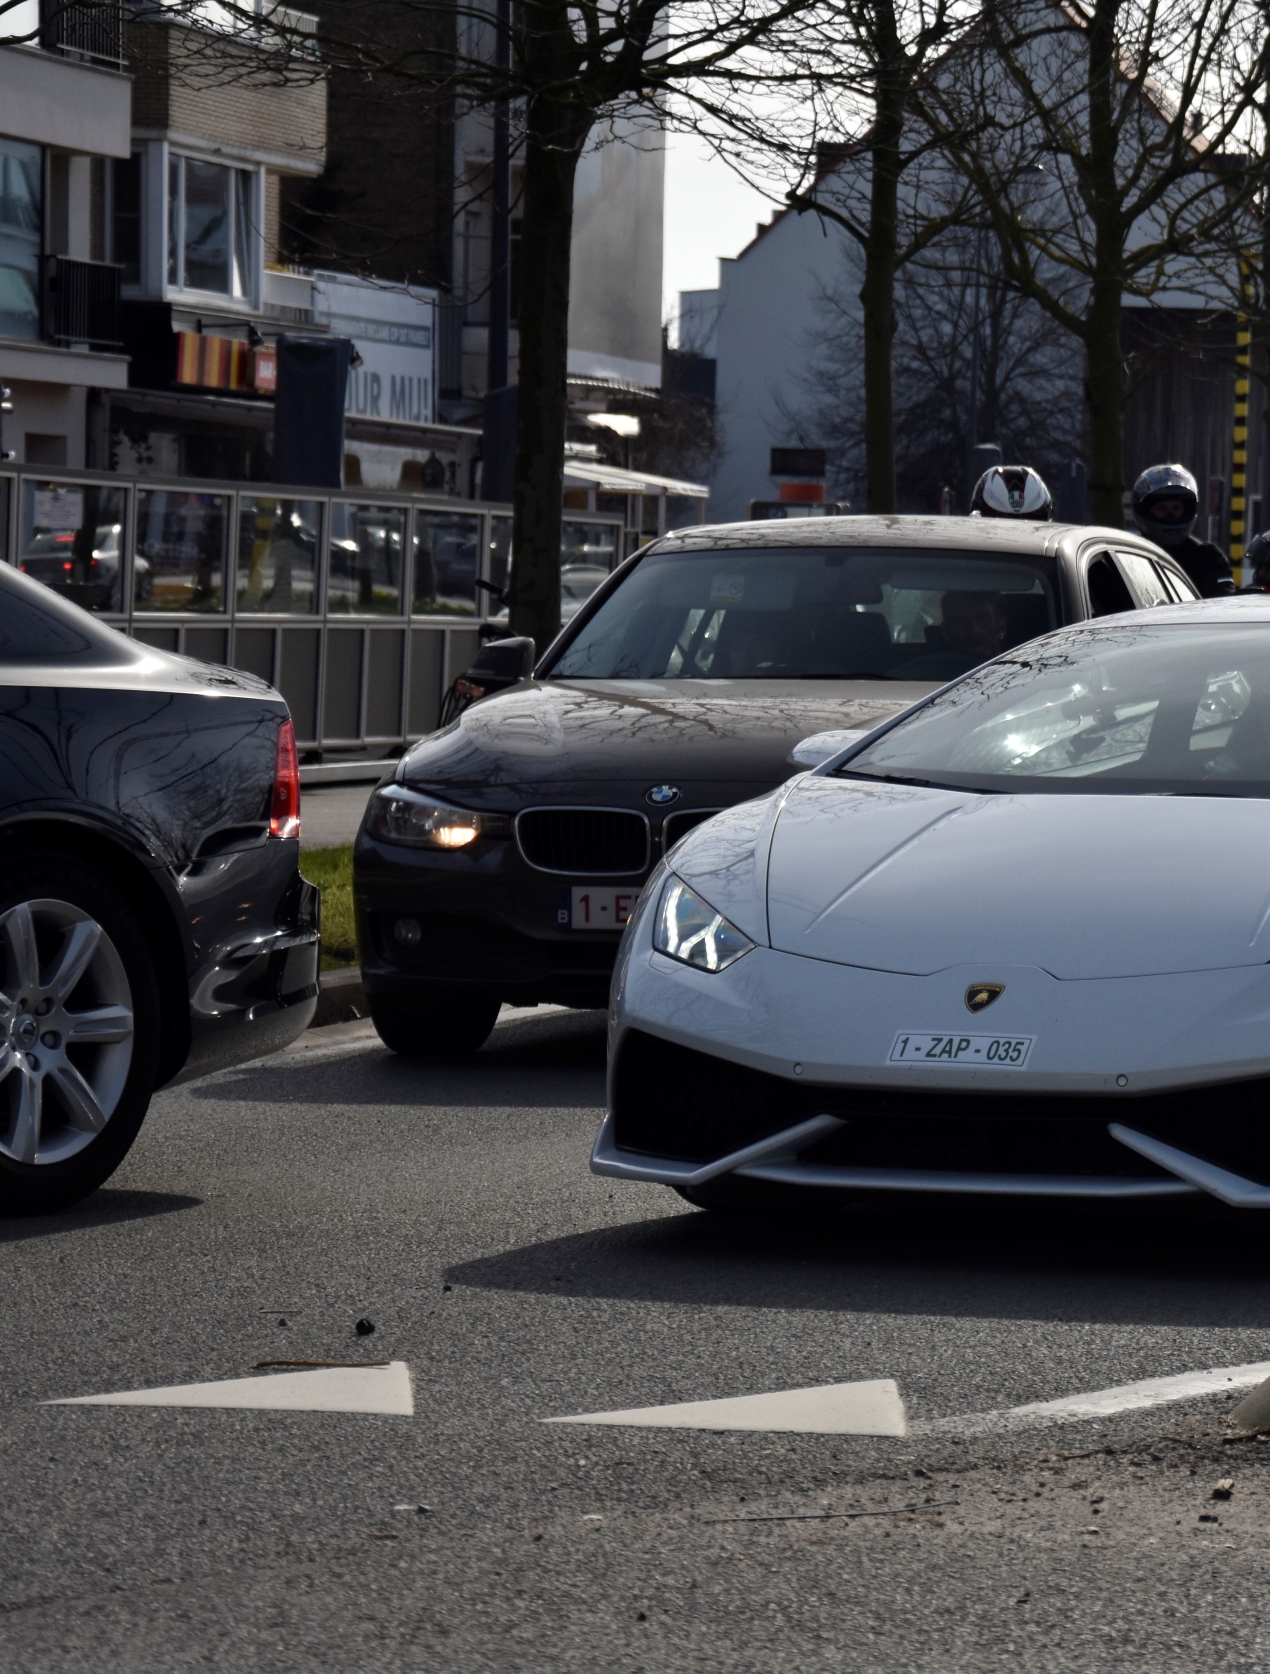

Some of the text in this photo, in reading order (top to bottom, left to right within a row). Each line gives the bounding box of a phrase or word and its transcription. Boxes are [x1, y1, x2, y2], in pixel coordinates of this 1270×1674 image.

[389, 373, 428, 424] MIJ!
[558, 909, 569, 923] B
[580, 894, 639, 924] 1-E
